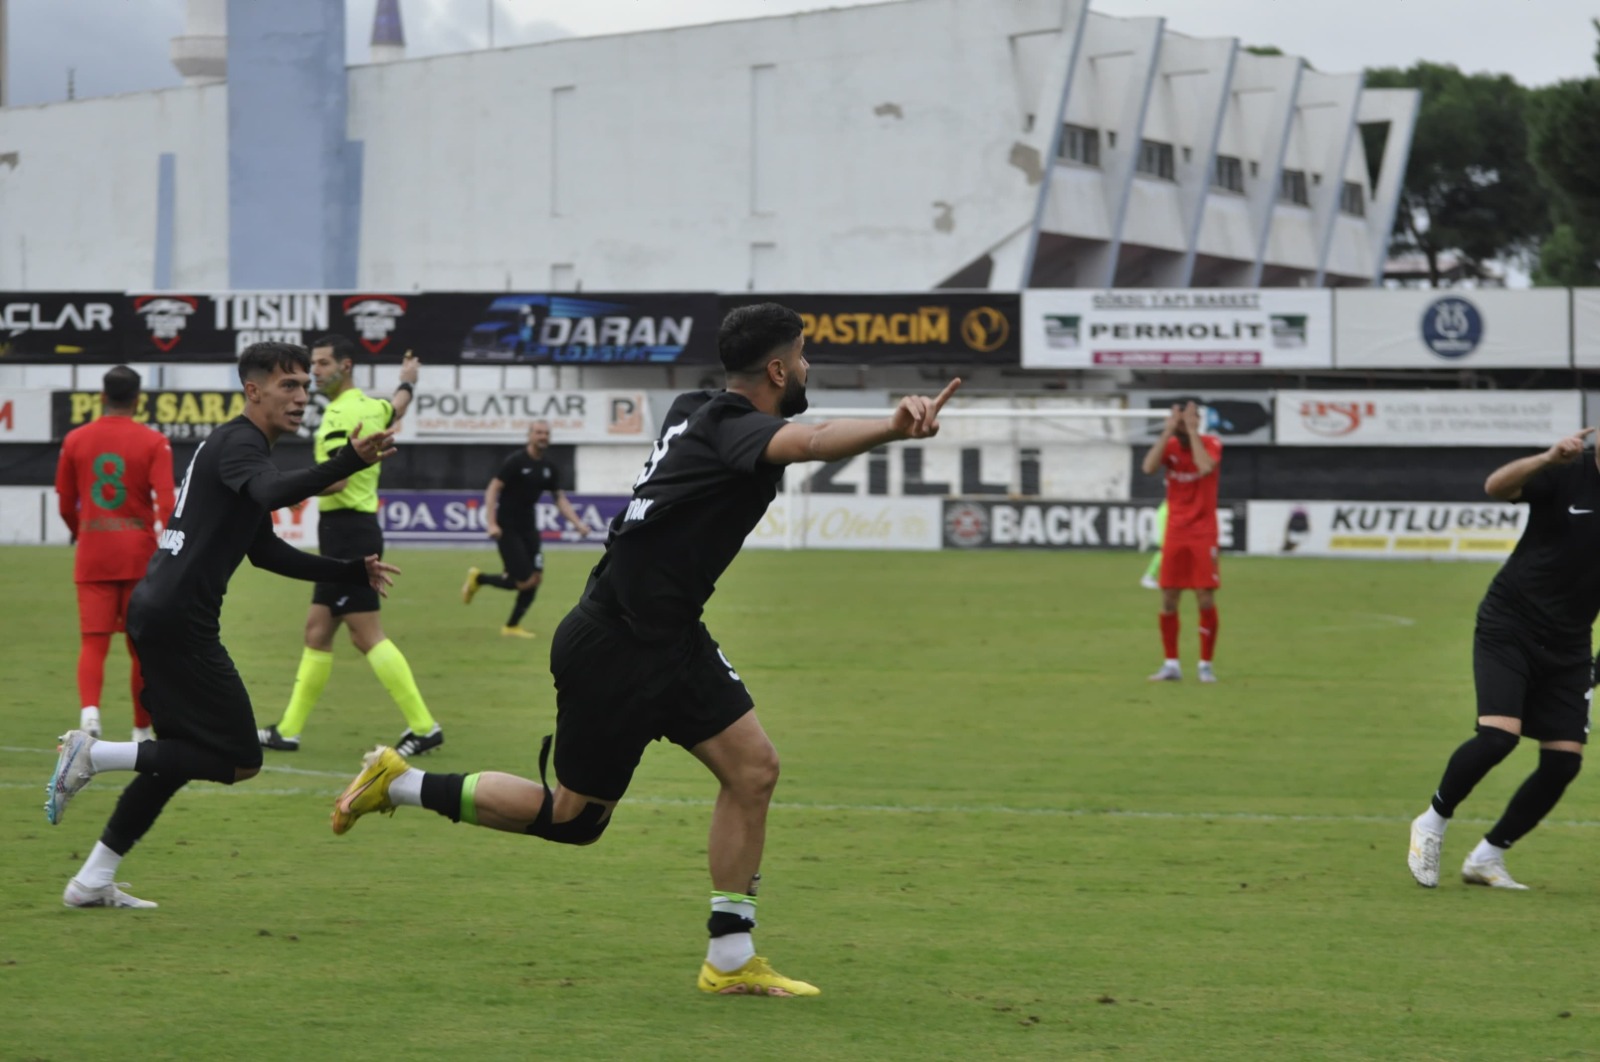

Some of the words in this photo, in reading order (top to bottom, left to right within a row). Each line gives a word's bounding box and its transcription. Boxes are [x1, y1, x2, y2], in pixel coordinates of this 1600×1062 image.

[0, 303, 114, 337] ÇLAR
[209, 294, 330, 331] TOSUN
[540, 316, 693, 346] DARAN
[1089, 319, 1263, 340] PERMOLİT
[156, 393, 246, 424] SARA
[415, 395, 587, 416] POLATLAR
[90, 452, 127, 510] 8
[990, 505, 1101, 545] BACK
[1106, 507, 1234, 547] HOE
[1332, 506, 1451, 532] KUTLU
[1457, 508, 1521, 528] GSM
